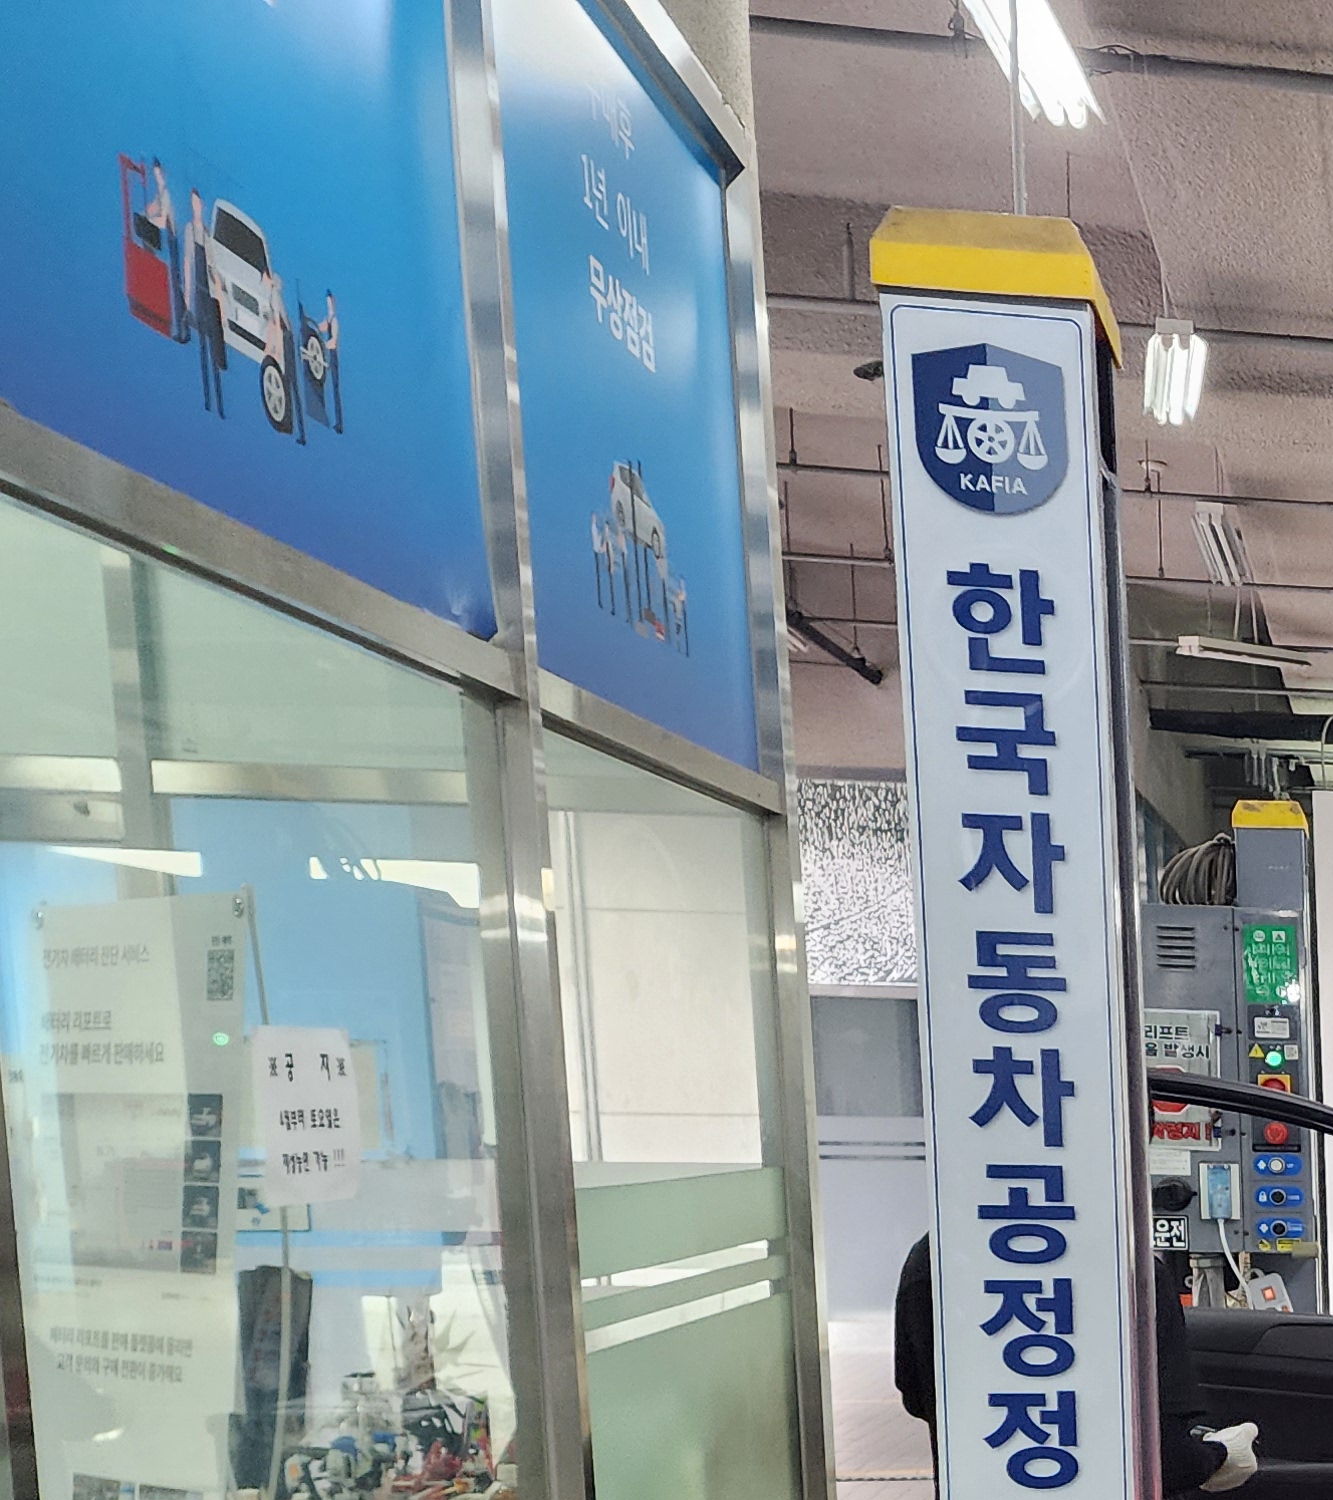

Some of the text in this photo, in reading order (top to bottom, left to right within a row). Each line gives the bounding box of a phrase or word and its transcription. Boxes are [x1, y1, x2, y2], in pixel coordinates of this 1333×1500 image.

[582, 154, 650, 276] 1년 이내
[589, 254, 656, 373] 무상점검
[960, 471, 1028, 496] KAFIA
[1144, 1025, 1189, 1040] 리프트
[1145, 1042, 1210, 1059] 음 발생시
[1153, 1219, 1186, 1248] 운전
